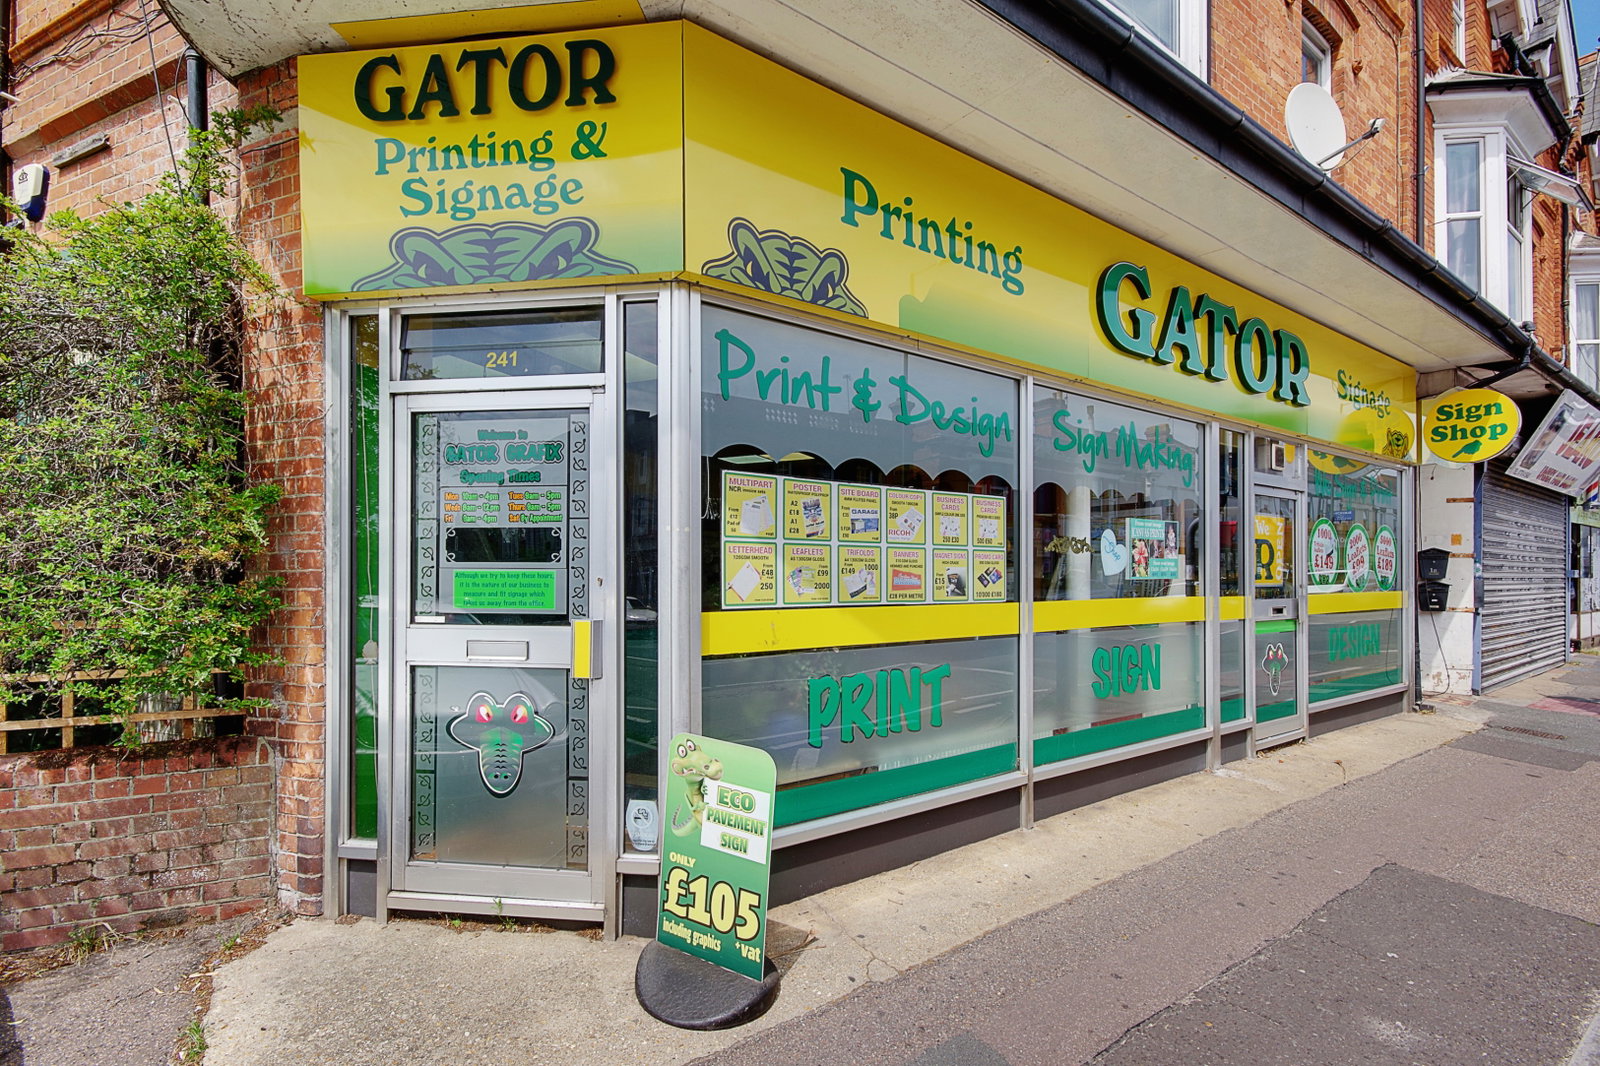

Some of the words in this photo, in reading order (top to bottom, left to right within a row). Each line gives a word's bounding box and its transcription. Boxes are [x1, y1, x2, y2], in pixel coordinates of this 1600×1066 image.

[354, 39, 617, 122] GATOR
[374, 130, 556, 176] Printing
[570, 120, 608, 160] &
[400, 173, 584, 221] Signage
[840, 166, 1024, 296] Printing
[1095, 261, 1312, 408] GATOR
[486, 351, 518, 368] 241
[714, 328, 842, 412] Print
[852, 367, 882, 423] &
[889, 375, 1012, 458] Design
[1336, 368, 1391, 419] Signage
[1435, 402, 1504, 423] Sign
[1430, 422, 1509, 443] Shop
[445, 443, 499, 464] GATOR
[505, 442, 563, 463] GRAFIX
[1053, 409, 1109, 474] Sign
[1115, 420, 1194, 488] Making
[460, 469, 505, 485] Opening
[507, 468, 541, 483] Times
[728, 477, 773, 489] MULTIPART
[793, 483, 823, 492] POSTER
[840, 488, 856, 496] SITE
[856, 490, 879, 498] BOARD
[444, 492, 459, 501] Mon
[484, 492, 500, 502] 4pm
[508, 491, 525, 500] Tues
[546, 490, 561, 501] 5pm
[936, 496, 964, 504] BUSINESS
[976, 499, 1002, 507] BUSINESS
[444, 503, 461, 512] Weds
[482, 503, 500, 513] 12pm
[508, 502, 526, 512] Thurs
[546, 502, 562, 513] 5pm
[444, 514, 454, 523] Fri
[482, 514, 497, 524] 4pm
[508, 514, 520, 523] Sat
[520, 514, 529, 524] By
[529, 513, 563, 524] Appointment
[1255, 520, 1270, 535] We
[1317, 528, 1332, 539] 1000
[1349, 533, 1363, 549] 2000
[1379, 535, 1392, 547] 5000
[728, 545, 773, 554] LETTERHEAD
[792, 547, 824, 556] LEAFLETS
[953, 552, 966, 560] SIGNS
[1347, 544, 1368, 563] Leaflets
[1377, 545, 1395, 559] Leaflets
[1255, 538, 1275, 581] R
[1314, 554, 1334, 569] £149
[1352, 555, 1365, 570] £99
[1377, 557, 1393, 572] £189
[454, 572, 479, 580] Although
[489, 572, 498, 580] try
[935, 577, 945, 585] £15
[760, 582, 774, 590] 250
[814, 582, 830, 590] 2000
[1328, 623, 1381, 662] DESIGN
[1091, 643, 1161, 699] SIGN
[807, 663, 952, 748] PRINT
[717, 785, 756, 814] ECO
[706, 807, 767, 838] PAVEMENT
[720, 831, 749, 854] SIGN
[669, 851, 696, 868] ONLY
[662, 865, 761, 941] £105
[662, 916, 691, 946] including
[692, 930, 721, 953] graphics
